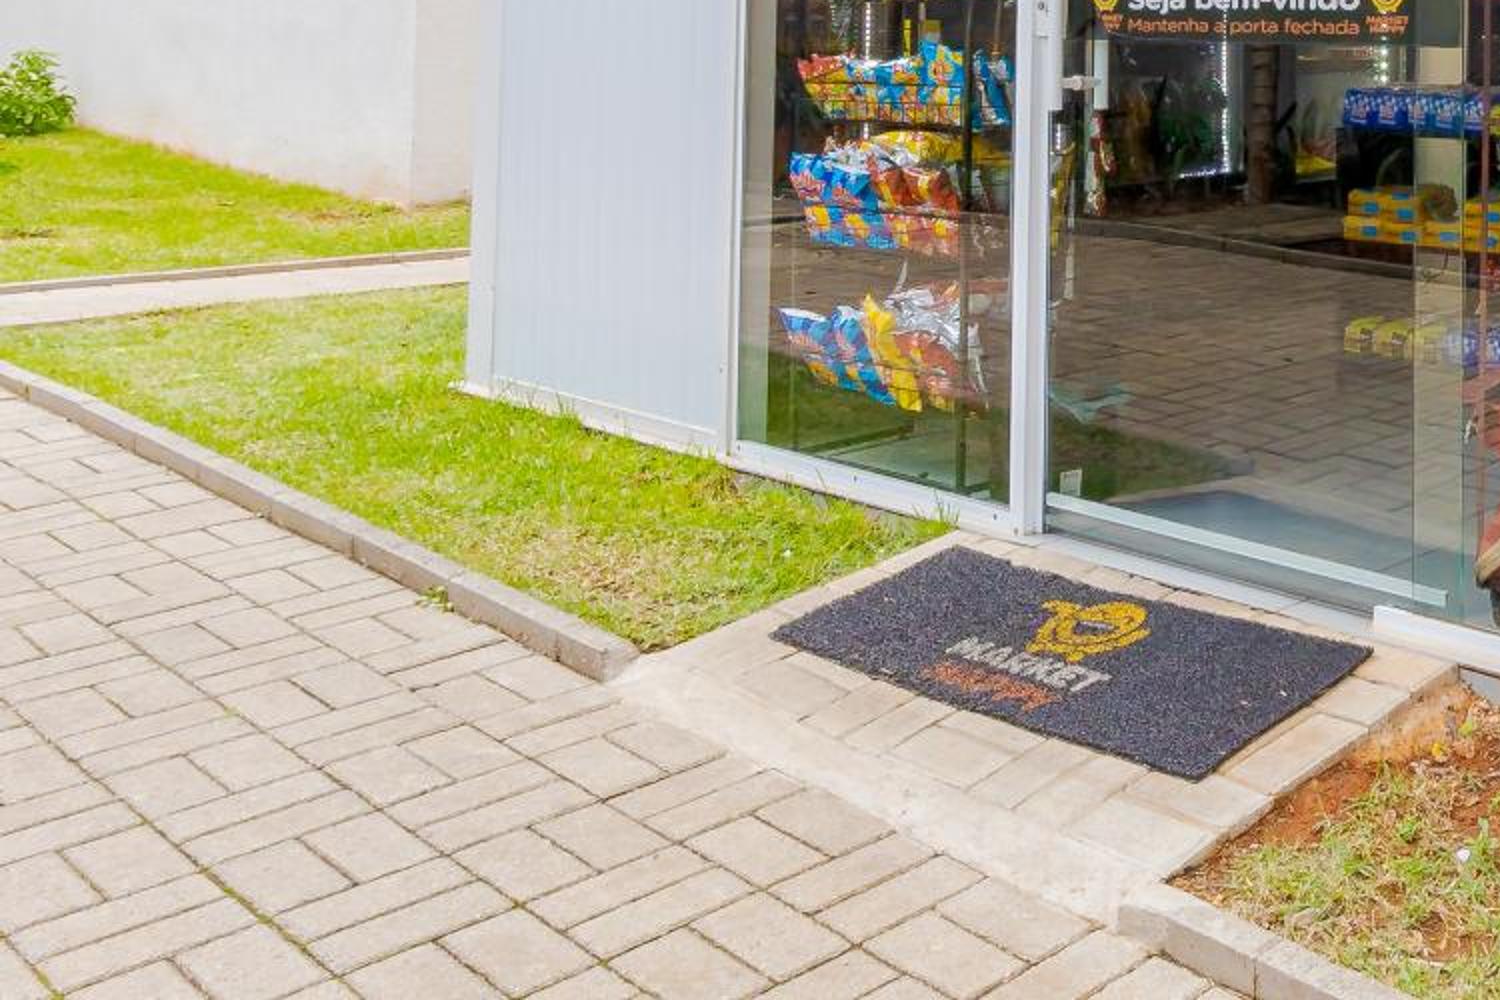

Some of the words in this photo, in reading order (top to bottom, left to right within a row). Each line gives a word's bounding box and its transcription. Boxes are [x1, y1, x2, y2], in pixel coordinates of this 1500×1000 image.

[1128, 18, 1209, 34] Mantenha
[1213, 22, 1224, 34] a
[1230, 20, 1280, 36] porta
[1285, 18, 1361, 35] fechada
[945, 636, 1113, 693] MARKET
